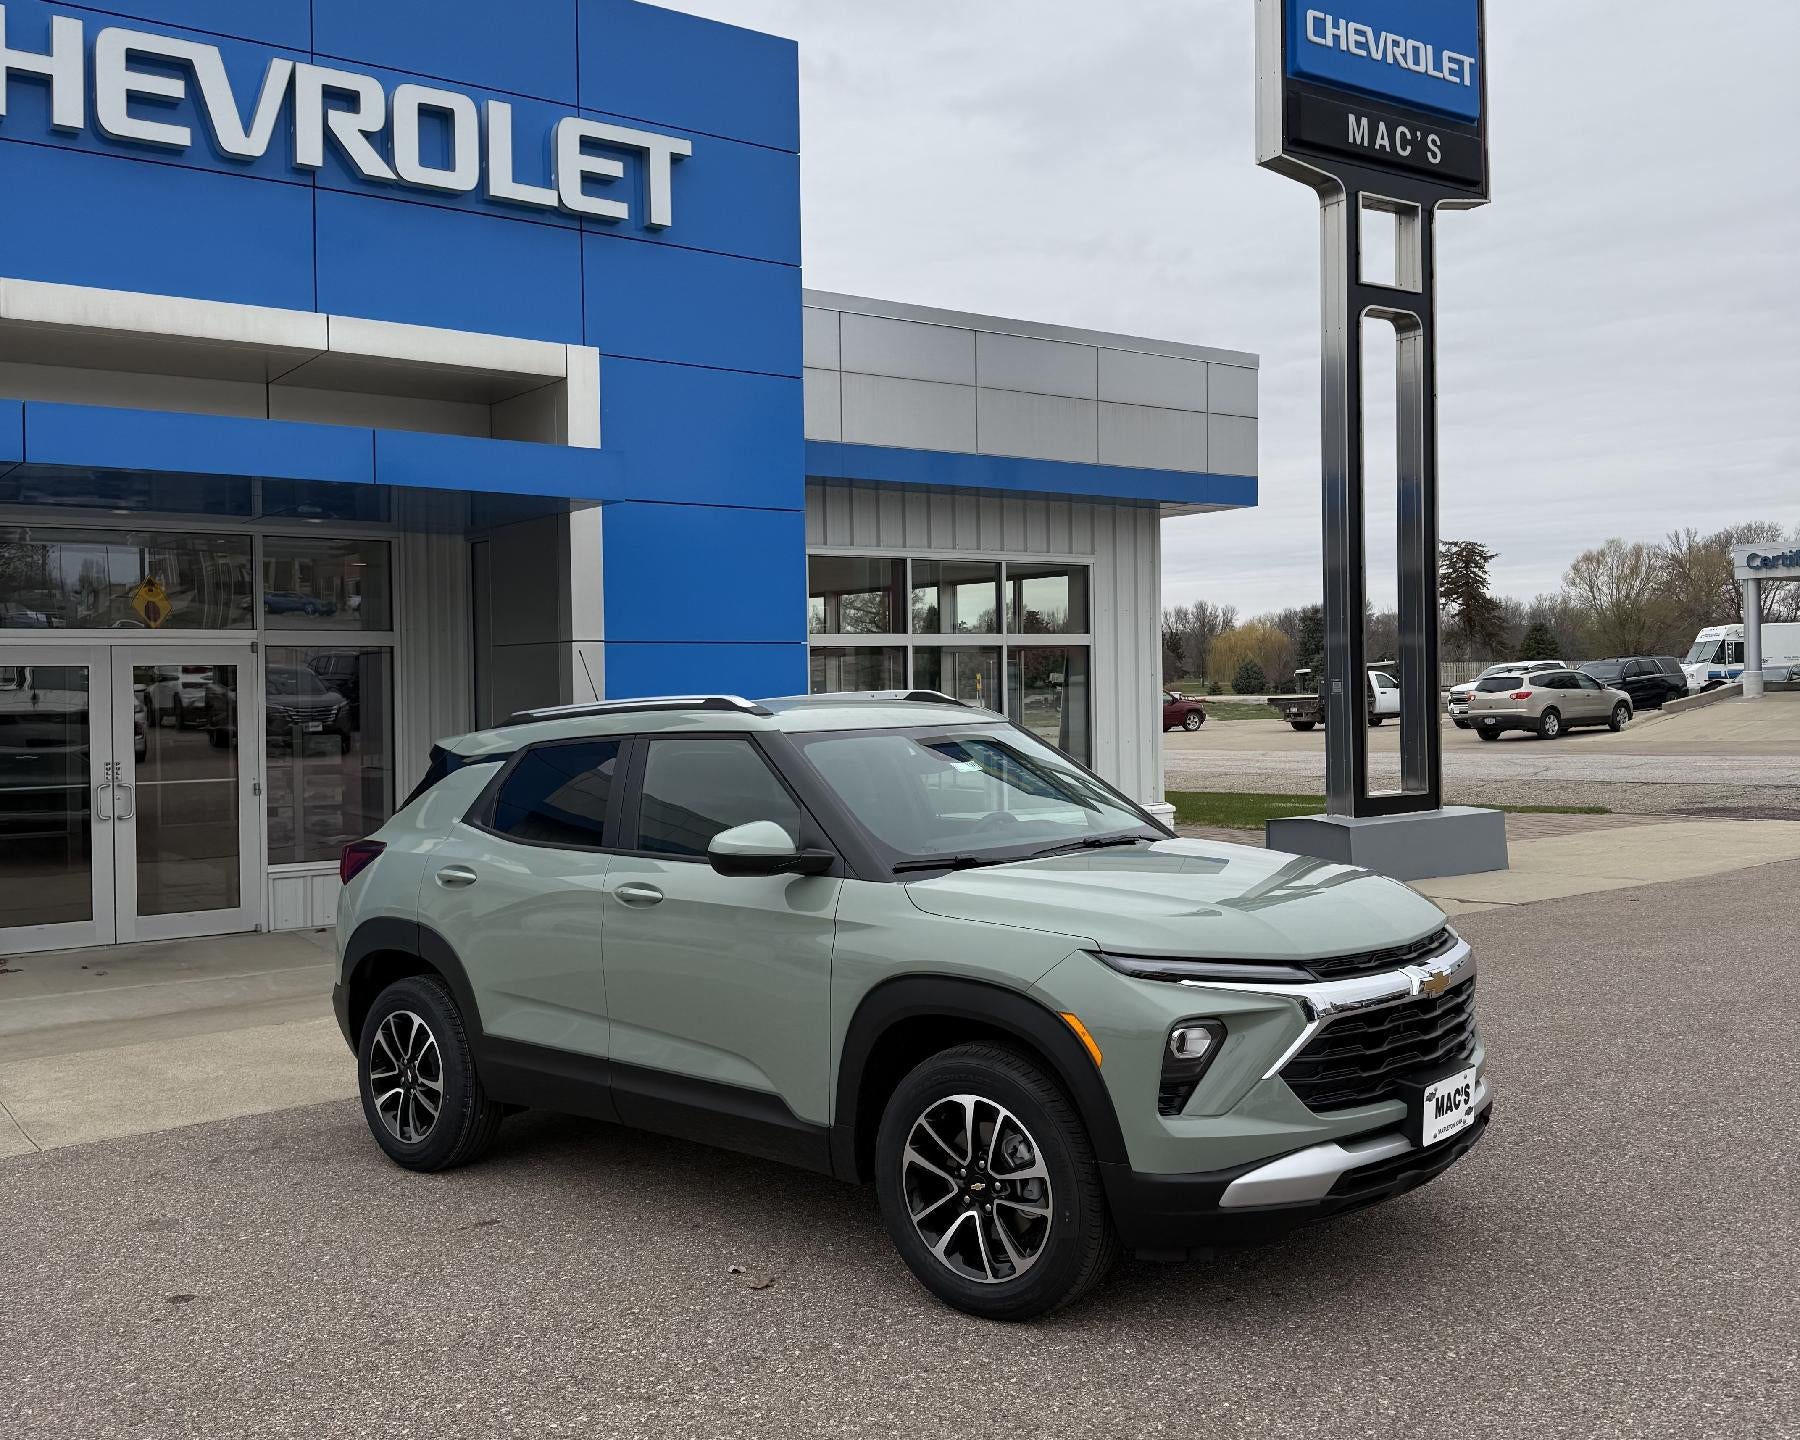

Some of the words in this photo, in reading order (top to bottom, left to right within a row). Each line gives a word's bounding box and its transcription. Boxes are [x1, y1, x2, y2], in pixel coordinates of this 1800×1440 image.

[1306, 9, 1475, 86] CHEVROLET
[1348, 113, 1442, 164] MAC'S
[1434, 1083, 1470, 1119] MAC'S
